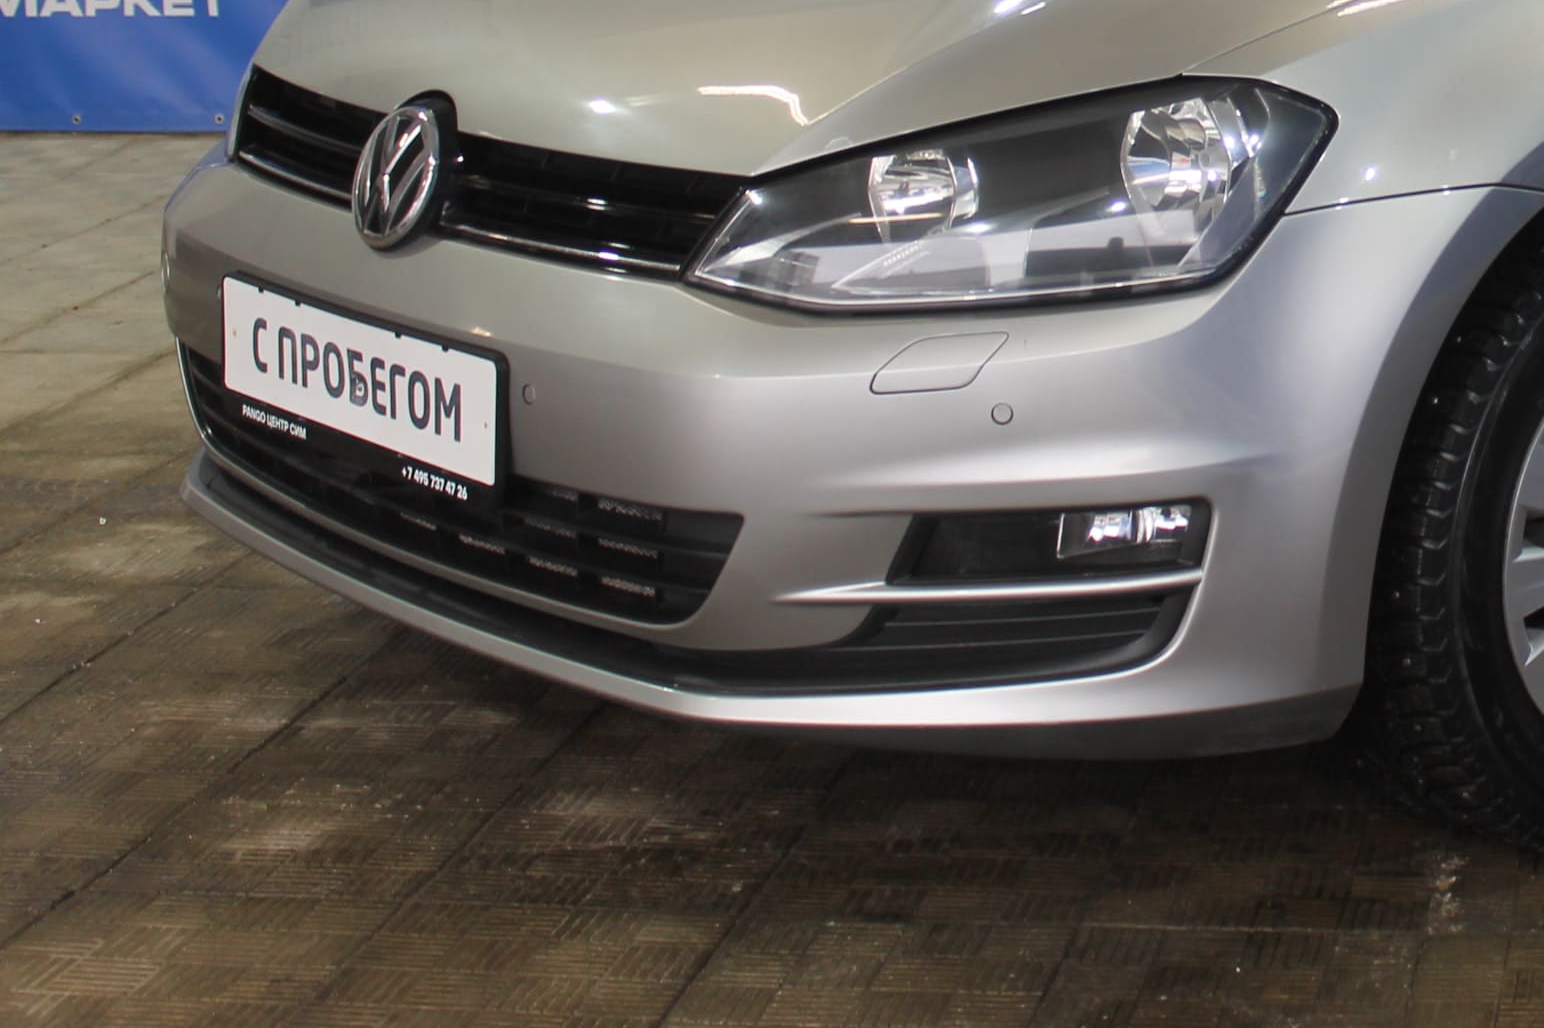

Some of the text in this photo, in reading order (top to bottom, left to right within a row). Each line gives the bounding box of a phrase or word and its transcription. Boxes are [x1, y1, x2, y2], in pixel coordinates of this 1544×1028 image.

[252, 318, 462, 443] С ПРОБЕГОМ
[242, 404, 307, 440] PANGO ЦЕНТР СИМ
[413, 469, 429, 486] 495
[430, 473, 445, 492] 737
[445, 480, 456, 496] 47
[456, 484, 468, 500] 26
